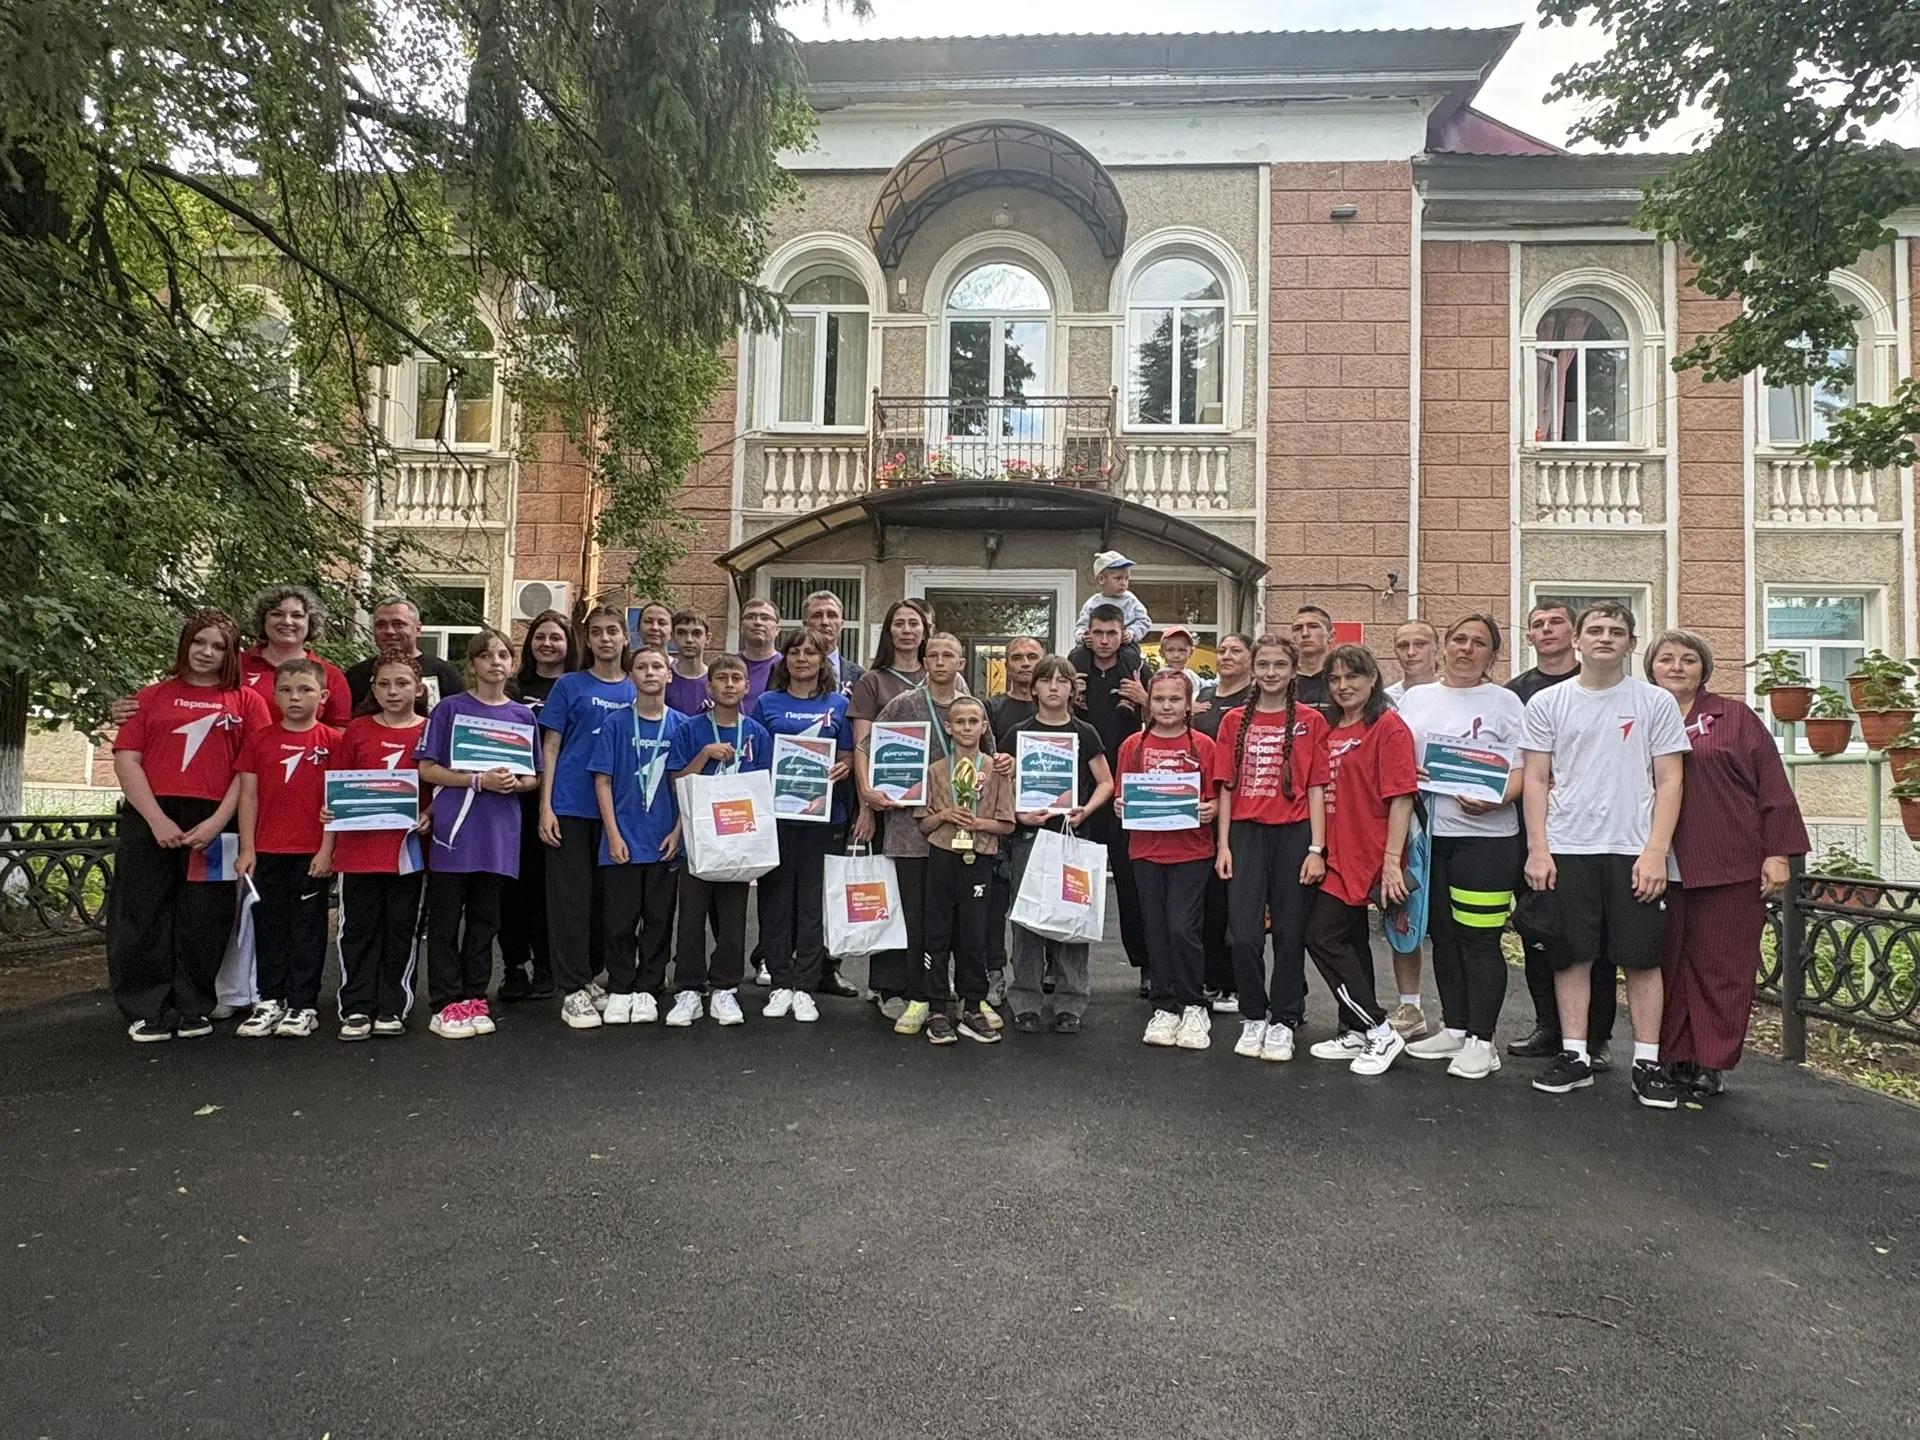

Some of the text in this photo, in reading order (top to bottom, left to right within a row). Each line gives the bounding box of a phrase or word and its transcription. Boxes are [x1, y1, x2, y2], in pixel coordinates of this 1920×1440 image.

[174, 698, 223, 710] Первые
[591, 696, 631, 710] Первые
[631, 737, 672, 750] Первые
